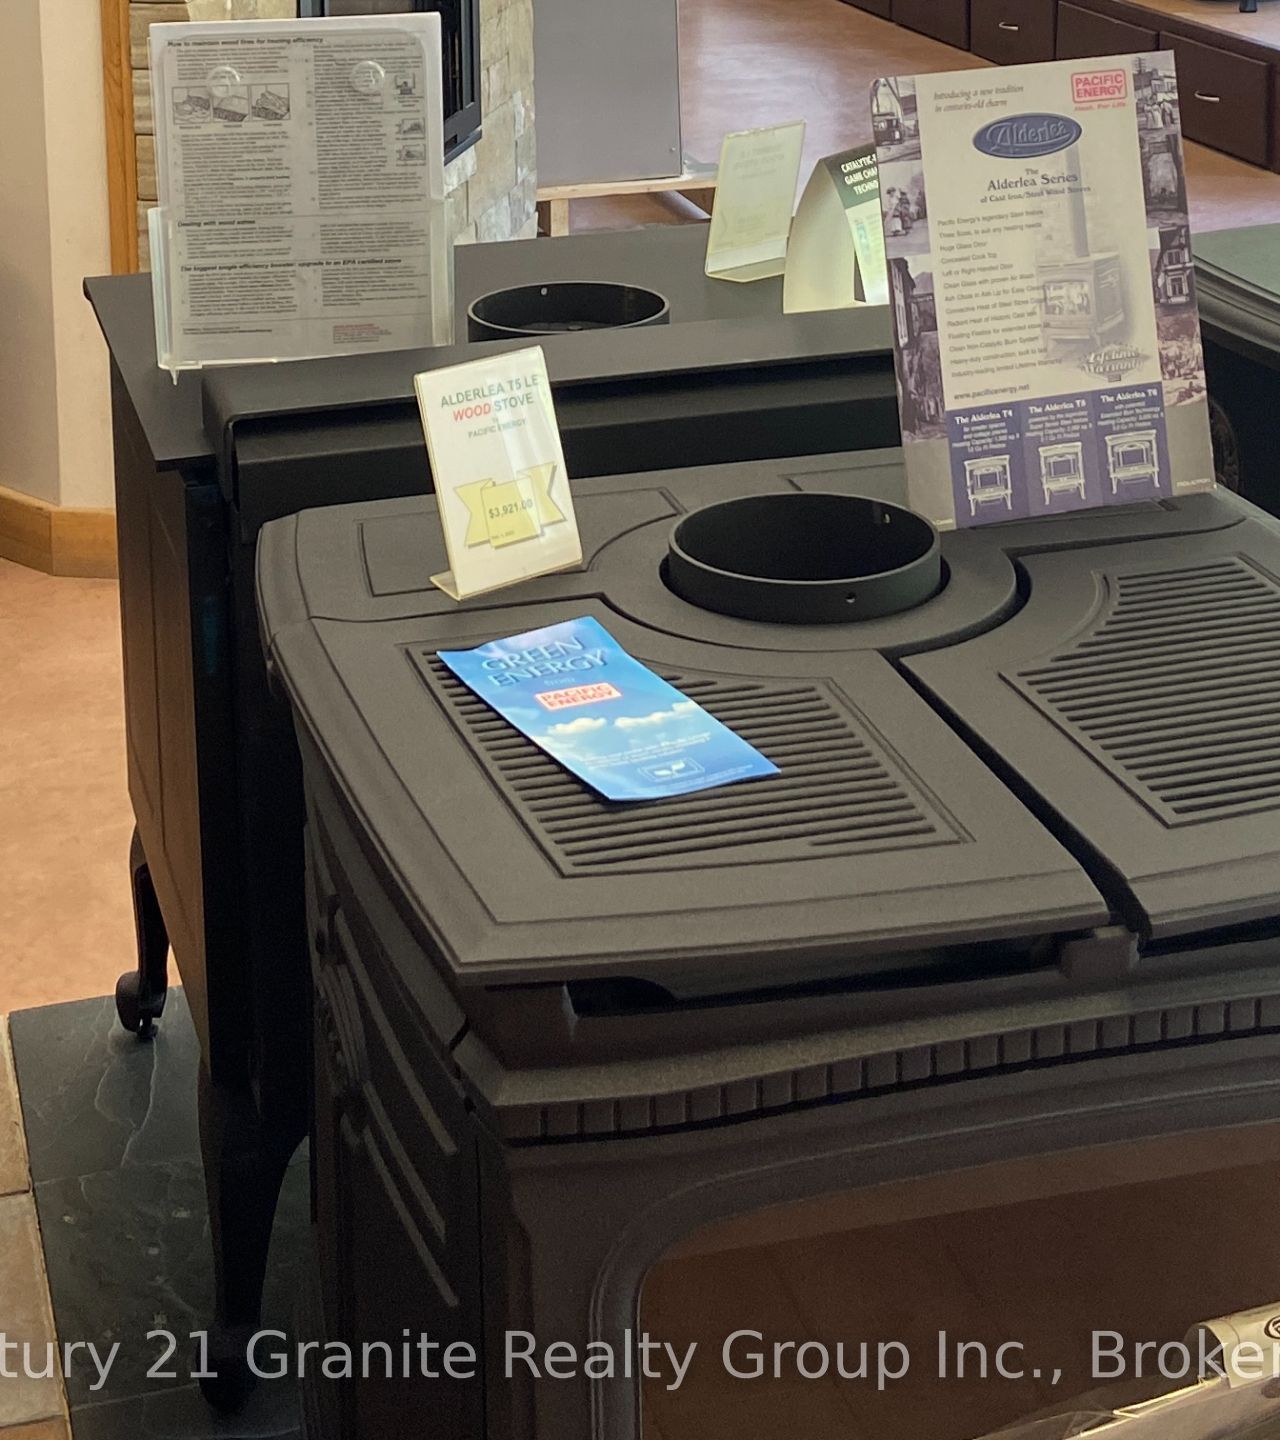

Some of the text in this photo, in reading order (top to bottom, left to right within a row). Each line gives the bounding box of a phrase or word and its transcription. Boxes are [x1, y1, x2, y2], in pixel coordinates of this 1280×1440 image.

[1075, 73, 1123, 88] PACIFIC
[934, 89, 971, 101] Introducing
[995, 85, 1024, 94] tradition
[1076, 84, 1125, 98] ENERGY
[985, 99, 1008, 108] charm
[986, 120, 1070, 151] Alderlea
[1025, 168, 1039, 176] The
[987, 173, 1078, 191] Alderlea Series
[989, 194, 1006, 202] Cast
[441, 374, 538, 408] ALDERLEA T5 LE
[953, 384, 1029, 400] www.pacificenergy.net
[1100, 394, 1114, 403] The
[1116, 391, 1146, 401] Alderlea
[453, 392, 534, 422] WOOD STOVE
[1028, 406, 1042, 414] The
[1044, 402, 1074, 412] Alderlea
[954, 416, 969, 425] The
[970, 412, 1001, 423] Alderlea
[468, 425, 496, 439] PACIFIC
[488, 499, 533, 519] $3,921.00
[481, 634, 585, 671] GREEN
[487, 648, 608, 687] ENERGY
[540, 684, 611, 702] PACIFIC
[546, 690, 614, 708] ENERGY
